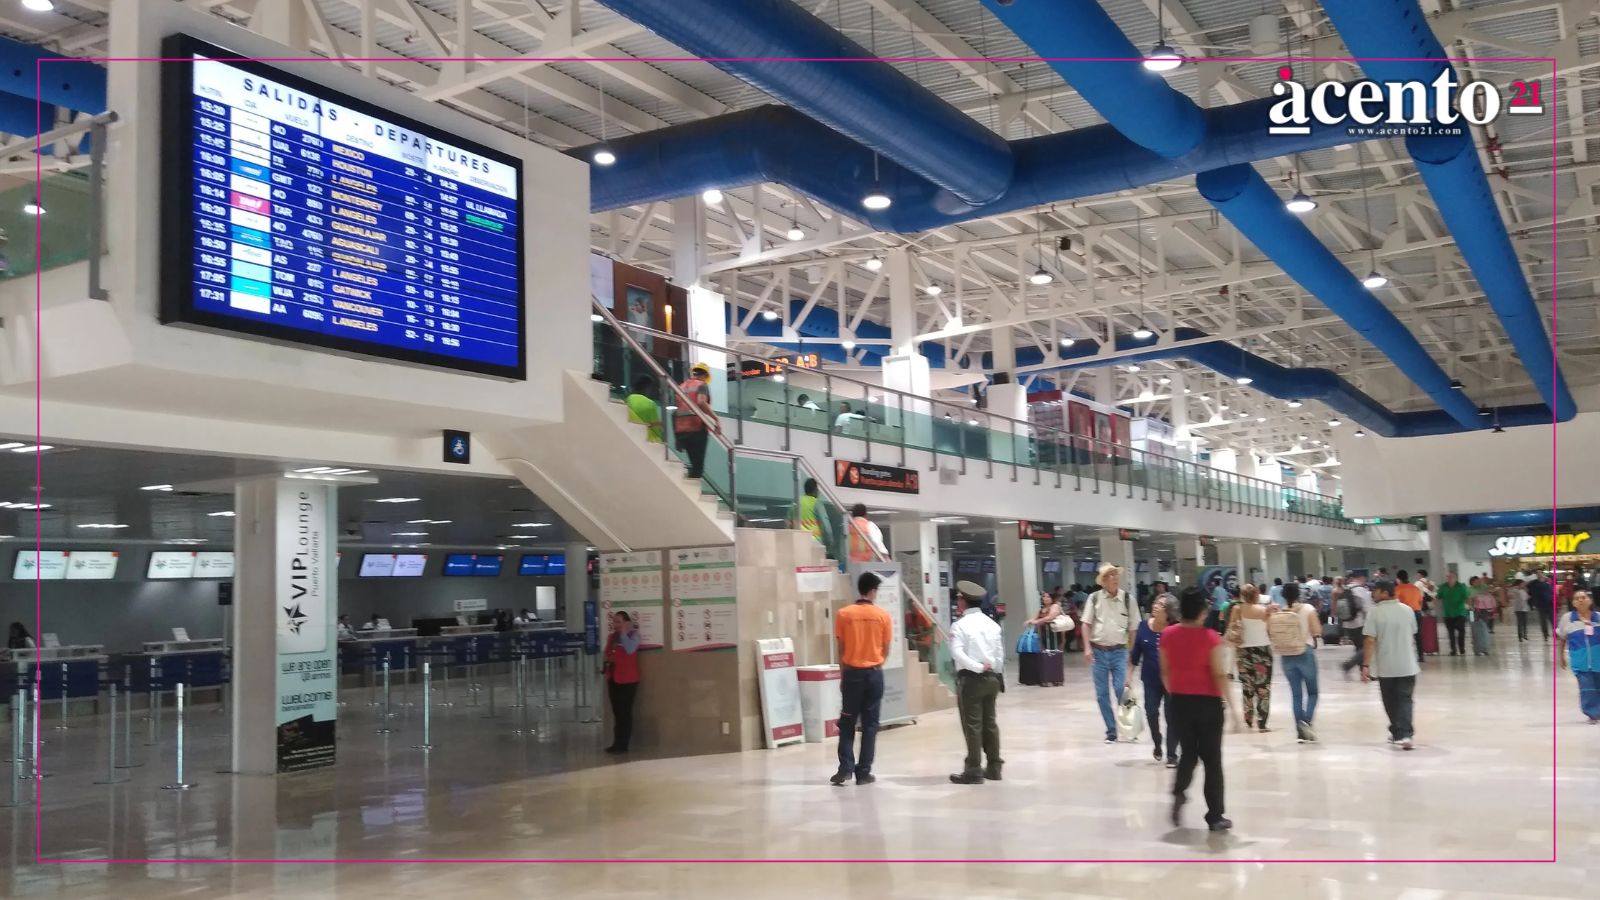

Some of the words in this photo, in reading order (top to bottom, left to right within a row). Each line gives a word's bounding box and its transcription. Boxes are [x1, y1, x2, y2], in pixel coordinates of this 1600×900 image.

[244, 78, 338, 121] SALIDAS
[375, 124, 490, 174] DEPARTURES
[346, 134, 375, 149] DESTINO
[333, 144, 365, 160] MEXICO
[332, 159, 372, 178] HOUSTON
[331, 190, 383, 211] MONTERREY
[273, 204, 292, 217] TAR
[331, 221, 387, 242] GUADALAJAR
[331, 237, 379, 255] AGUASCALI
[272, 255, 287, 264] AS
[332, 285, 371, 299] GATWICK
[272, 303, 287, 313] AA
[332, 300, 383, 317] VANCOUVER
[311, 531, 320, 564] Vallarta
[1488, 531, 1592, 556] SUBWAY
[311, 567, 319, 597] Puerto
[298, 661, 312, 671] are
[314, 659, 331, 671] open
[281, 691, 333, 705] welcome
